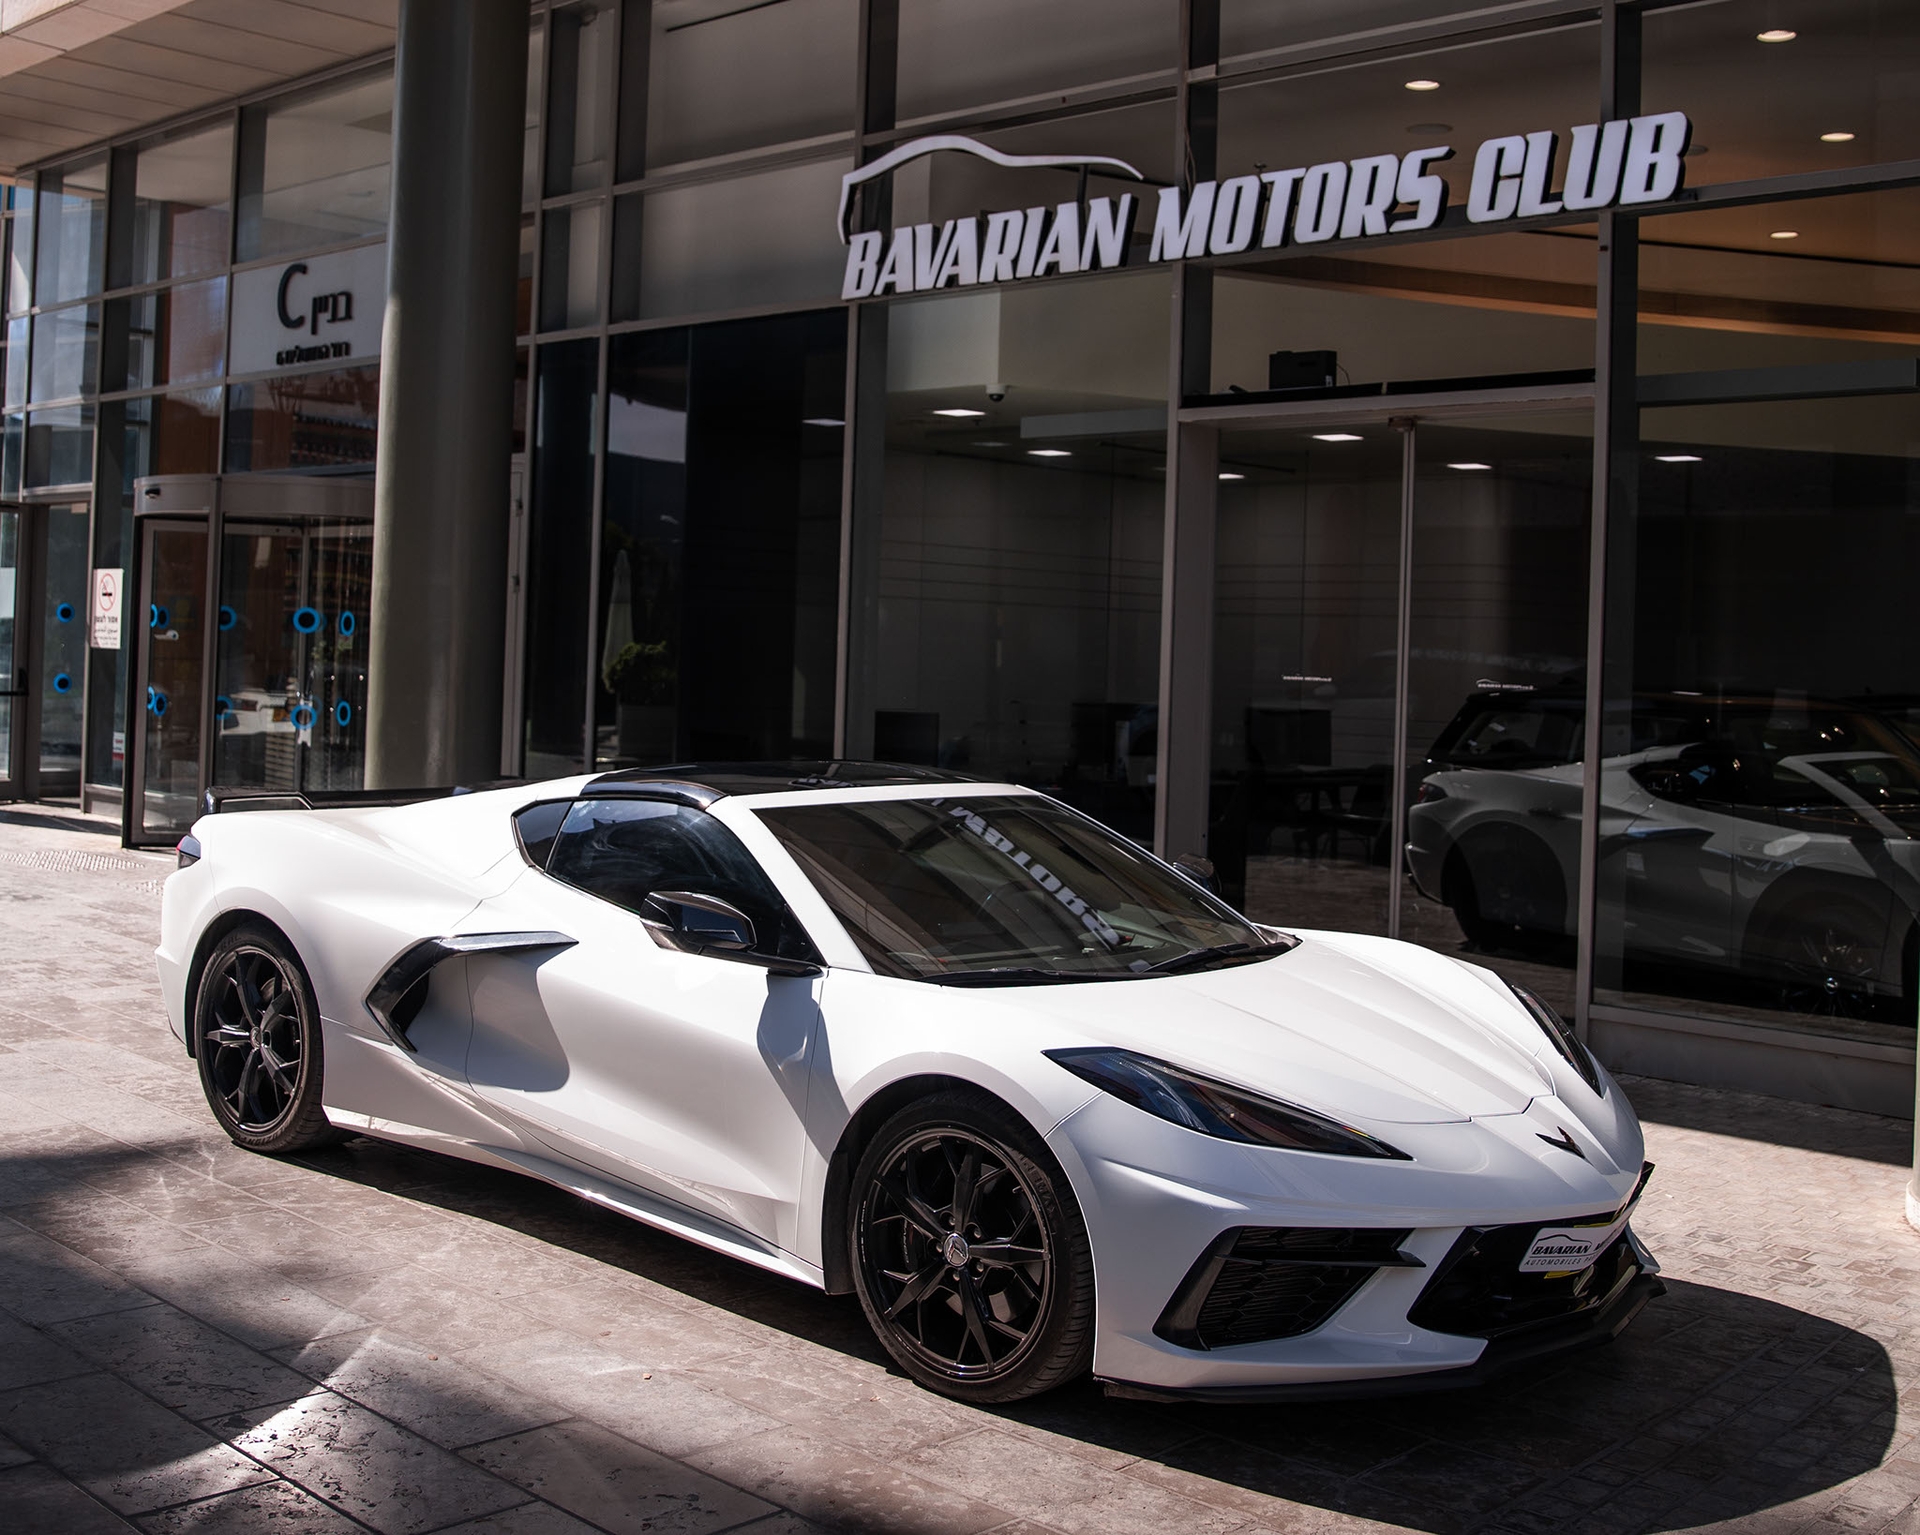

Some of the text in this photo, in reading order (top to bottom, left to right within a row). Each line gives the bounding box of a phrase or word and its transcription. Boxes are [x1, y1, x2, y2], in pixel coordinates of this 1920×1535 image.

[841, 111, 1688, 300] BAVARIAN MOTORS CLUB
[277, 262, 353, 336] בניין C
[1524, 1257, 1582, 1266] AUTOMOBILES
[1532, 1245, 1592, 1255] BAVARIAN
